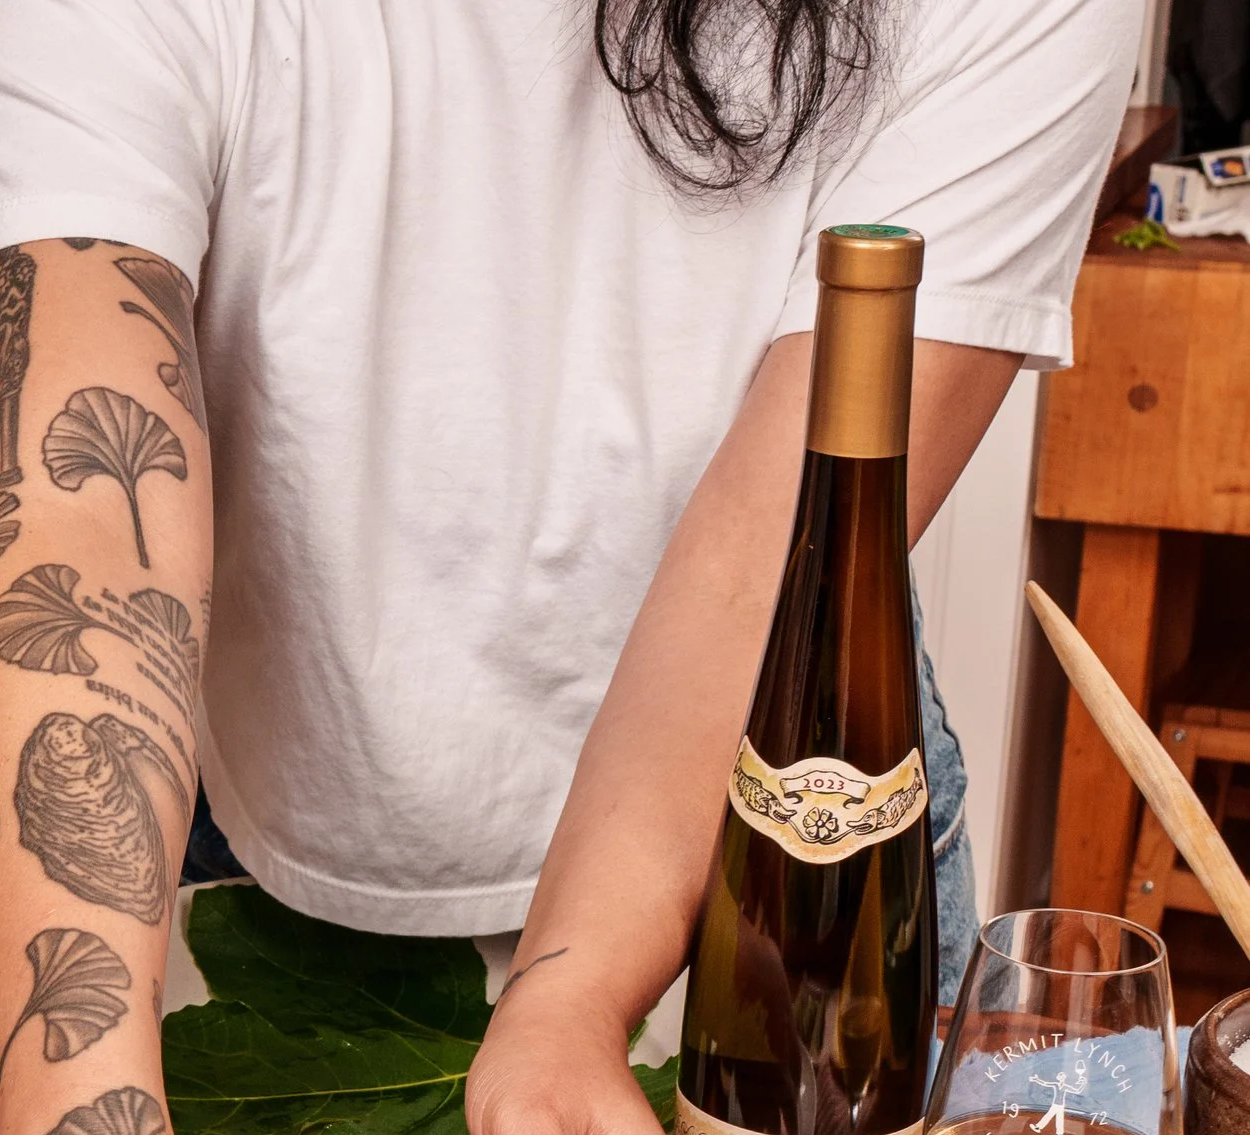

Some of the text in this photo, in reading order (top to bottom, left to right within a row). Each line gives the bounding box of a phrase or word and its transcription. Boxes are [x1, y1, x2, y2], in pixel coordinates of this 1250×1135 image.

[802, 778, 846, 791] 2023
[984, 1033, 1133, 1094] KERMIT LYNCH
[1001, 1100, 1108, 1126] 19 72
